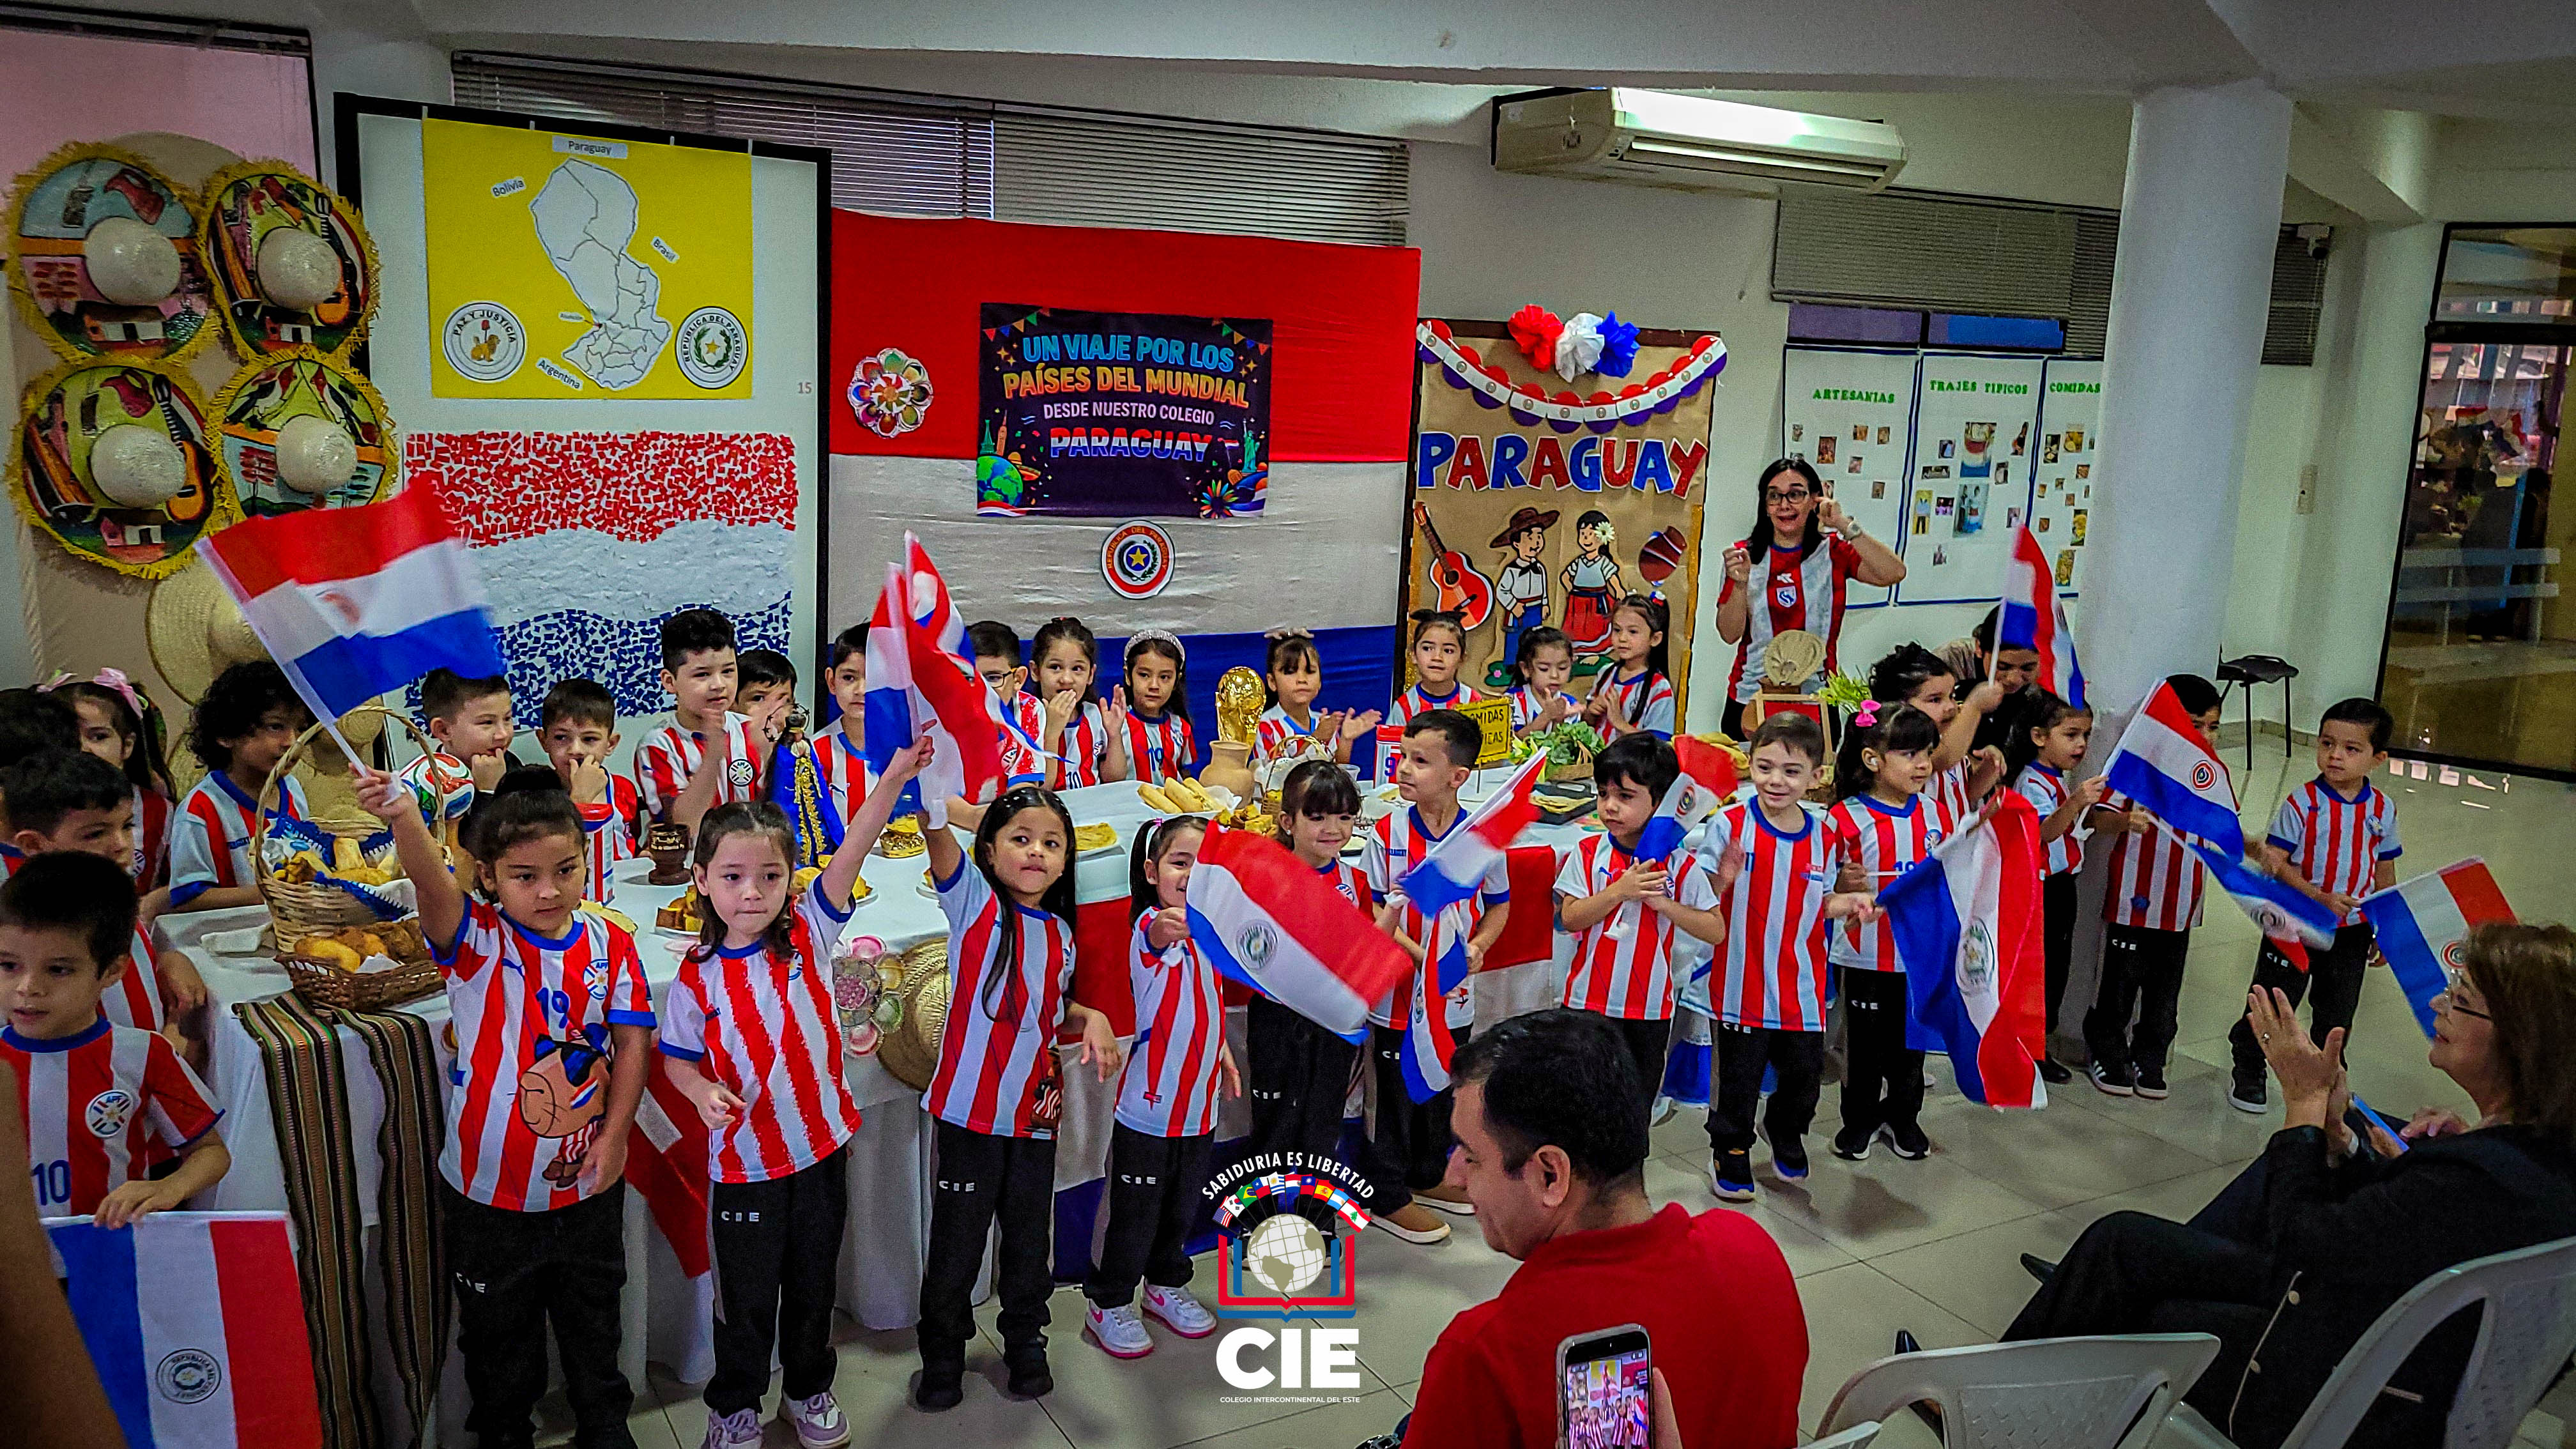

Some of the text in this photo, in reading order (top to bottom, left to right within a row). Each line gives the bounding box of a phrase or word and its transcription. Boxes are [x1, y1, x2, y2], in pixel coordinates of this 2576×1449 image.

[568, 140, 612, 155] Paraguay
[492, 177, 525, 197] Bolivia
[654, 238, 676, 261] Brasil
[480, 310, 518, 343] JUSTICIA
[682, 316, 741, 371] REPUBLICA DEL PARAGUAY
[1022, 334, 1234, 372] UN VIAJE POR LOS
[539, 360, 580, 389] Argentina
[1002, 362, 1249, 408] PAÍSES DEL MUNDIAL
[798, 382, 812, 394] 15
[1929, 380, 2029, 395] TRAJES TIPICOS
[2049, 382, 2101, 394] COMIDAS
[1043, 401, 1215, 425] DESDE NUESTRO COLEGIO
[1050, 427, 1213, 462] PARAGUAY
[1417, 431, 1709, 500] PARAGUAY
[1107, 531, 1128, 569] REPUBLICA
[1149, 530, 1169, 570] PARAGUAY
[1471, 709, 1504, 724] MIDAS
[1483, 731, 1503, 745] ICAS
[535, 987, 571, 1029] 19
[31, 1160, 72, 1206] 10
[939, 1180, 975, 1192] CIE
[1121, 1174, 1156, 1184] CIE
[721, 1211, 760, 1222] CIE
[456, 1272, 486, 1294] CIE
